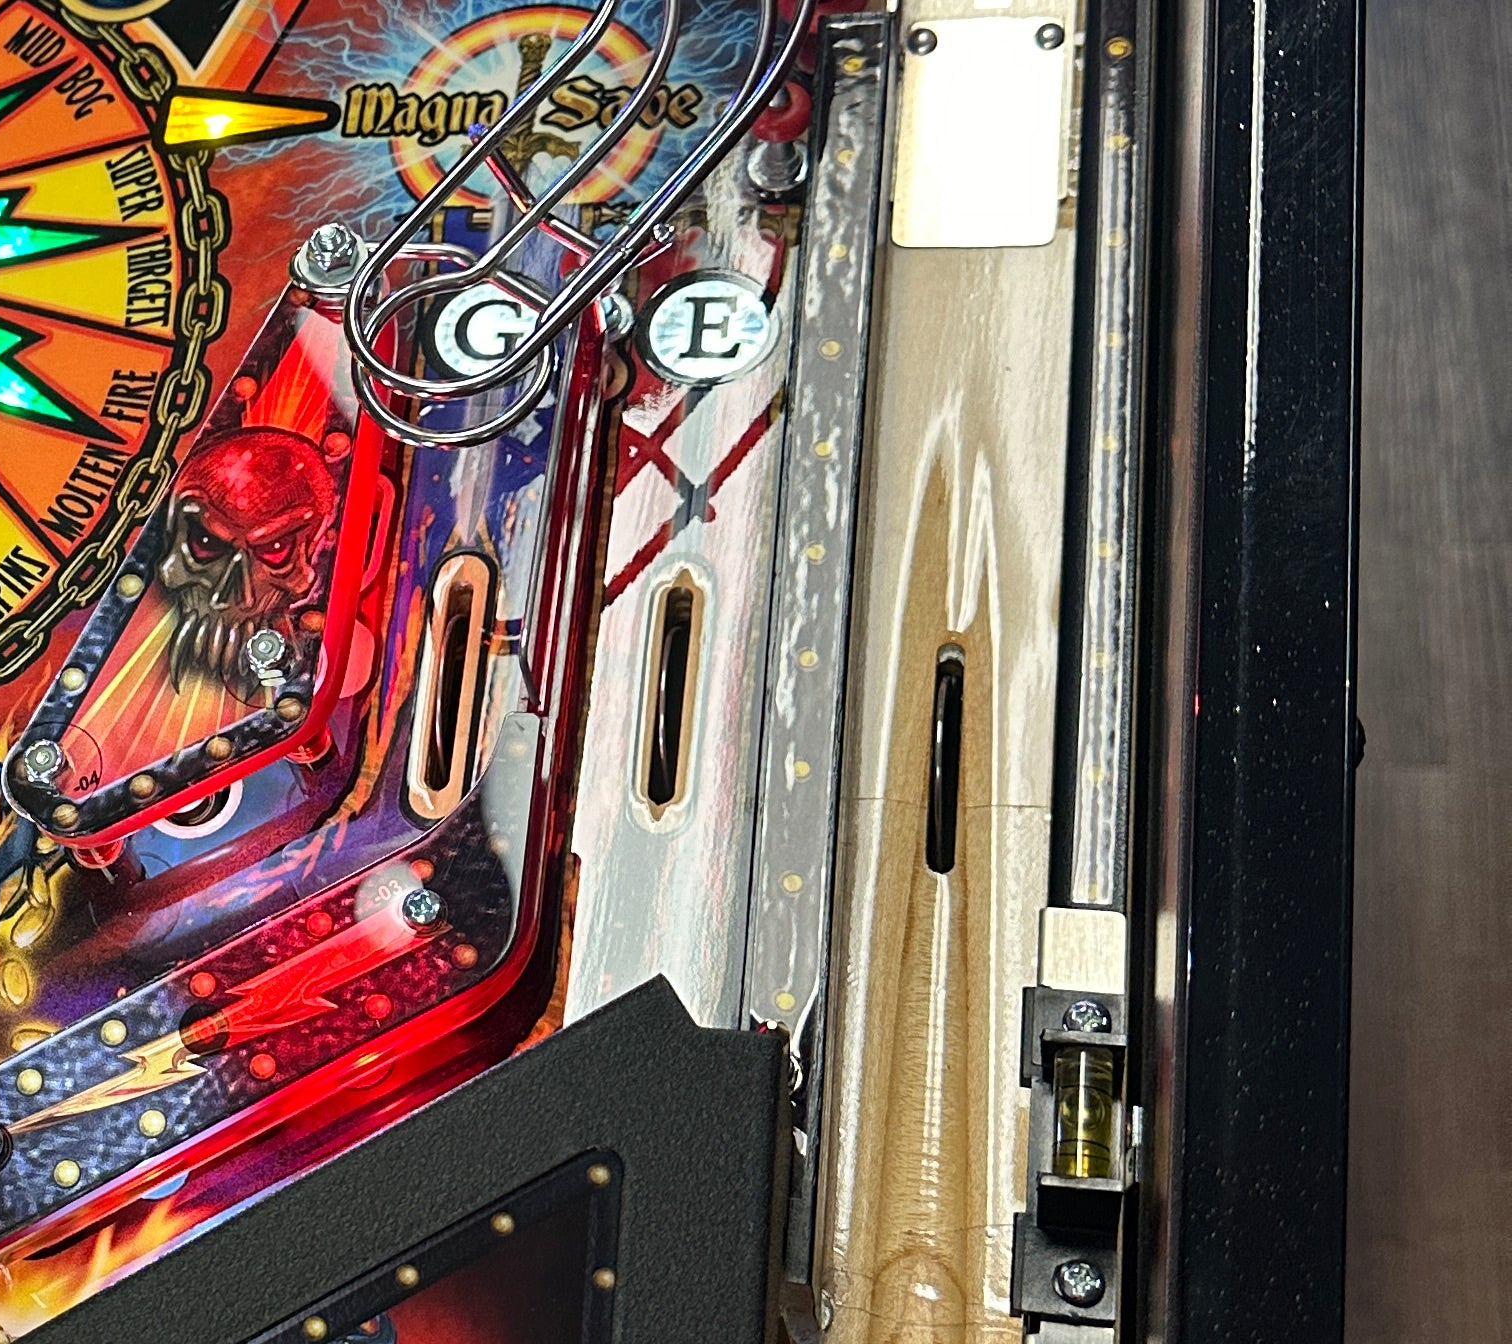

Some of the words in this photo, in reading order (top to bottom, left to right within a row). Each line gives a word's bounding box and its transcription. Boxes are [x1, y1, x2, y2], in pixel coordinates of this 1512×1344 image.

[3, 15, 66, 69] MUD
[53, 63, 115, 121] BOG
[342, 83, 508, 146] Magna
[541, 75, 703, 132] Save
[105, 144, 165, 222] SUPER
[124, 233, 173, 328] TARGETS
[679, 296, 740, 359] E
[37, 441, 127, 543] MOLTEN
[100, 369, 158, 425] FIRE
[73, 774, 101, 792] -04
